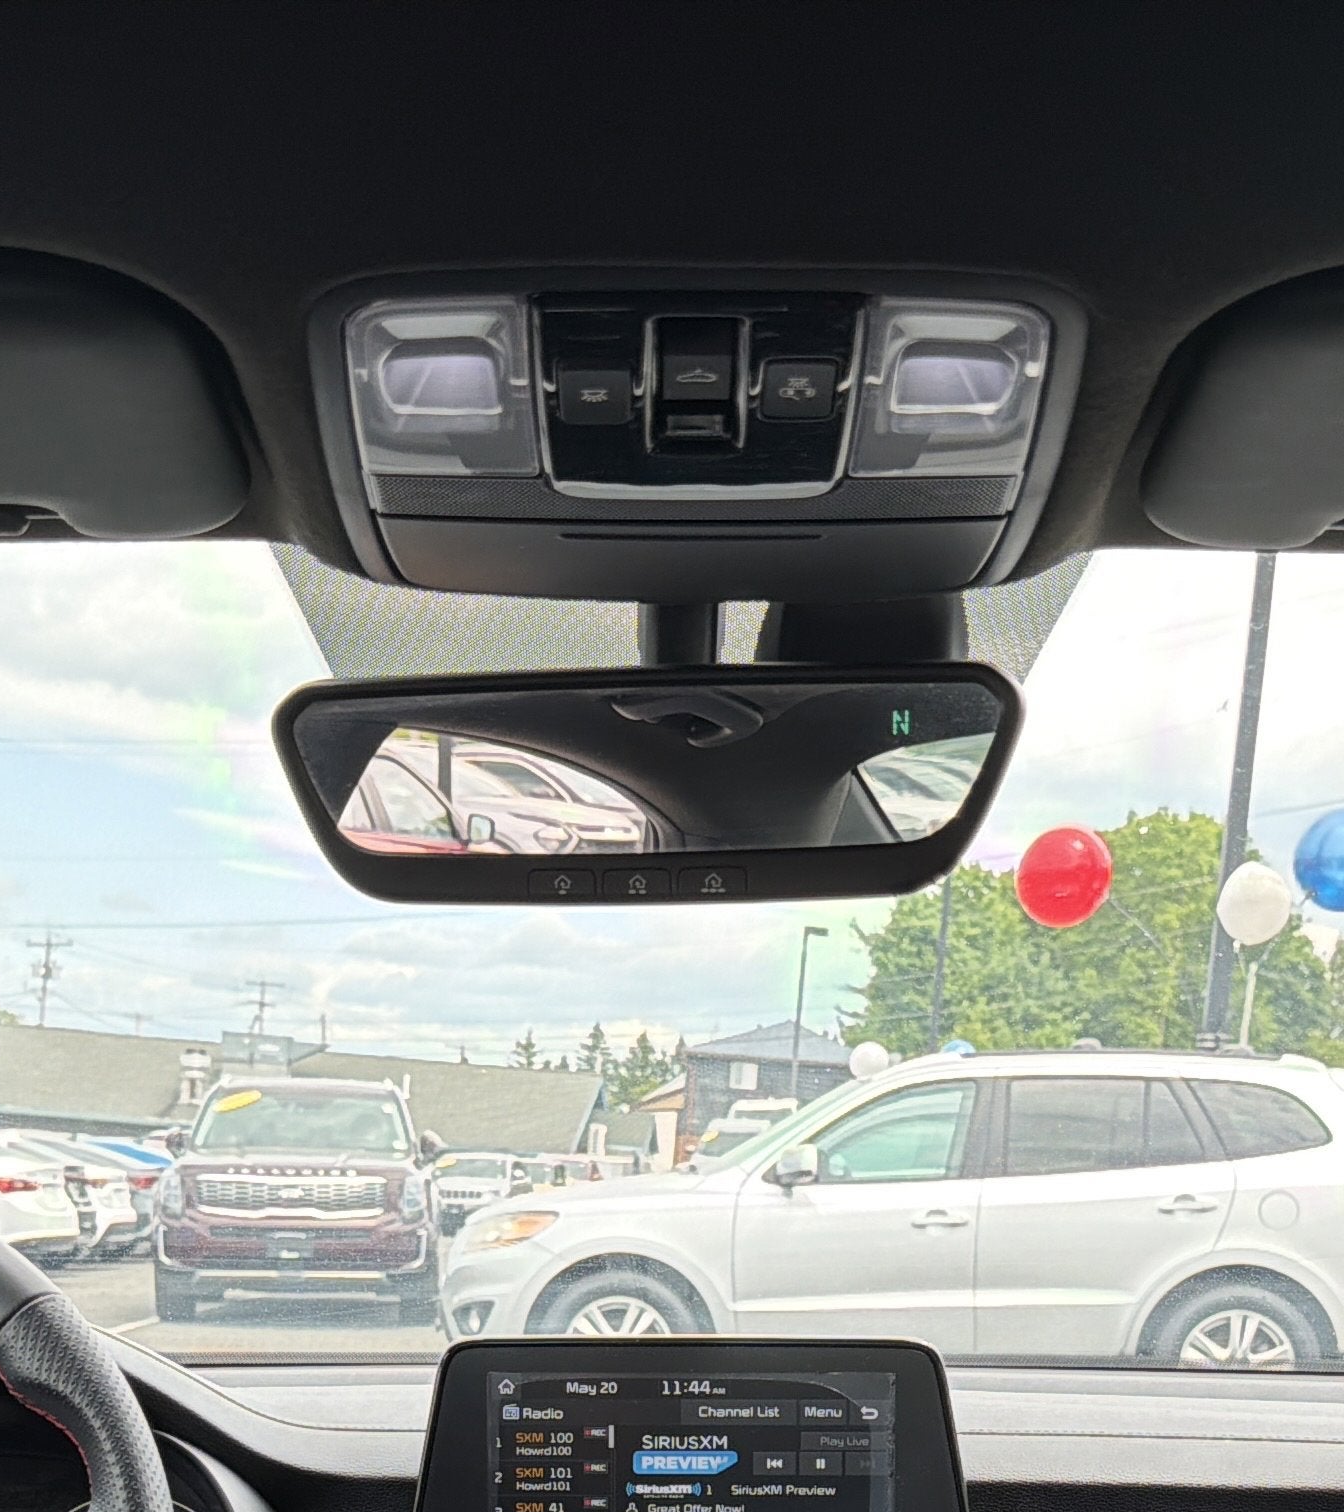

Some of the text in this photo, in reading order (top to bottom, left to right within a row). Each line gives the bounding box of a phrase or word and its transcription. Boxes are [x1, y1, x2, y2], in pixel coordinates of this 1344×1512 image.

[892, 709, 910, 736] N
[566, 1382, 618, 1395] May 20
[661, 1380, 726, 1395] 11:44 AM
[522, 1408, 564, 1420] Radio
[698, 1406, 780, 1418] Channel List
[804, 1406, 843, 1418] Menu
[495, 1437, 502, 1448] 1
[515, 1432, 574, 1444] SXM 100
[641, 1435, 729, 1450] SIRIUSXM
[819, 1436, 870, 1448] Play Live
[641, 1456, 729, 1470] PREVIEW
[494, 1472, 503, 1483] 2
[515, 1467, 573, 1479] SXM 101
[706, 1485, 713, 1496] 1
[730, 1484, 783, 1496] SiriusXM
[785, 1484, 837, 1496] Preview
